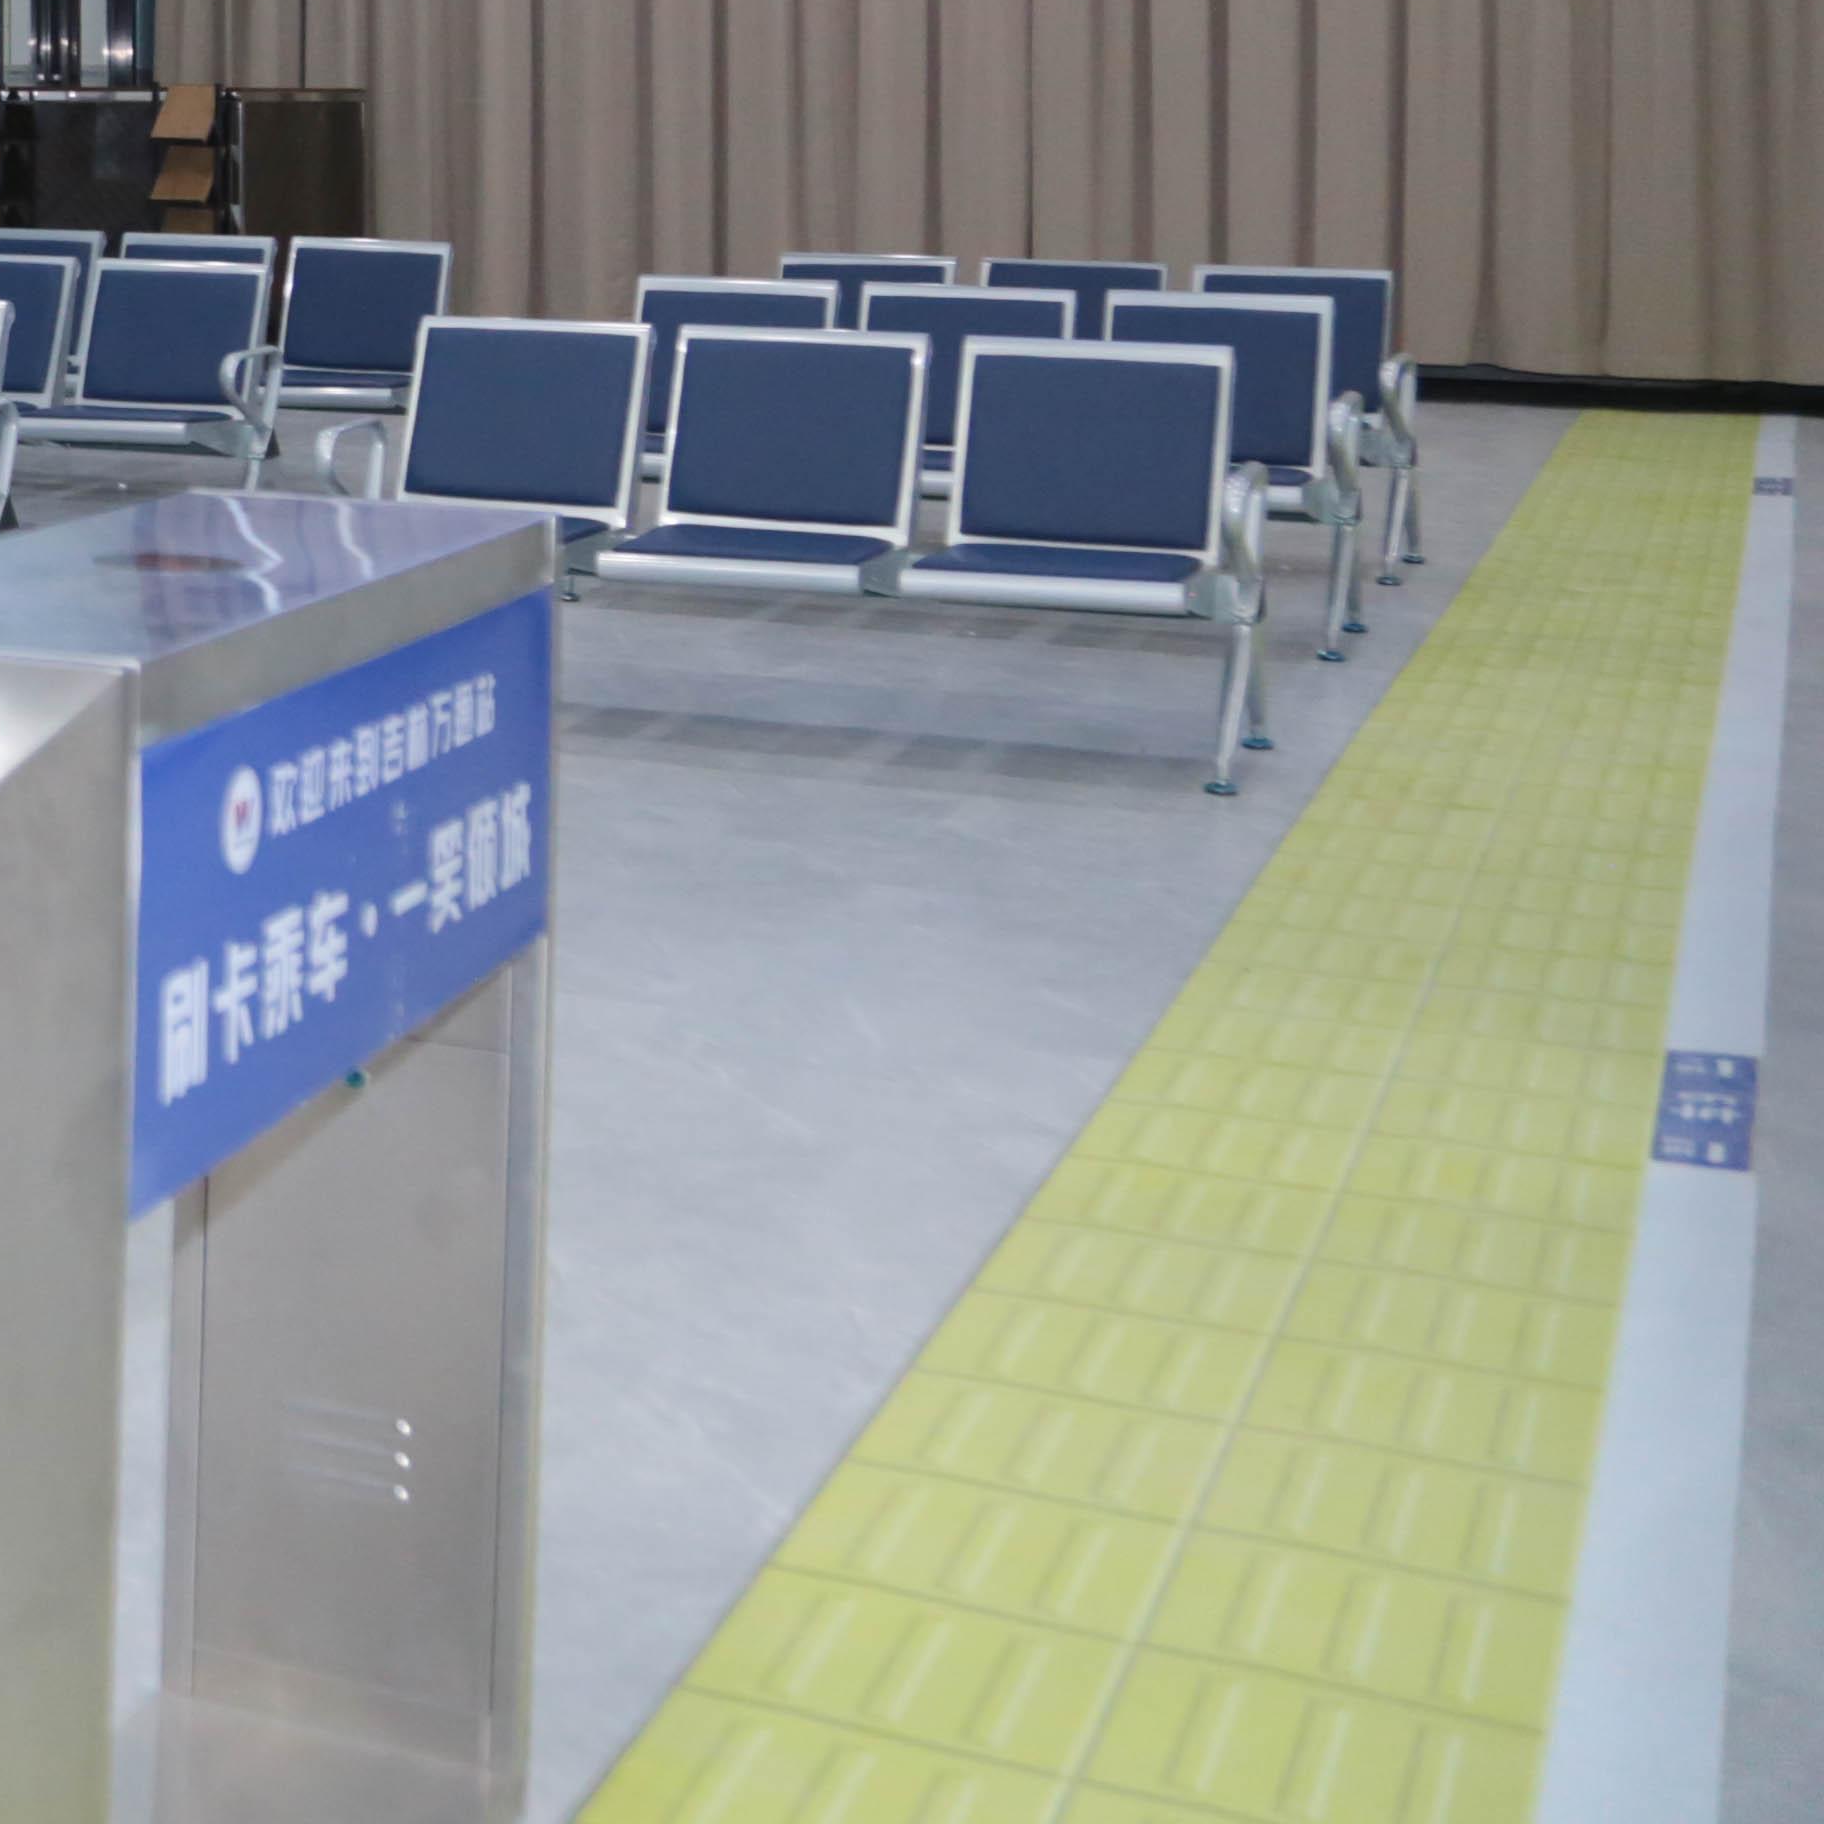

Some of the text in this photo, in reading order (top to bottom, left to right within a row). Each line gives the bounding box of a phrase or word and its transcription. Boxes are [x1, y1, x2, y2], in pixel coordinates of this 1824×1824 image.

[268, 673, 497, 838] 欢迎来到吉林万通站
